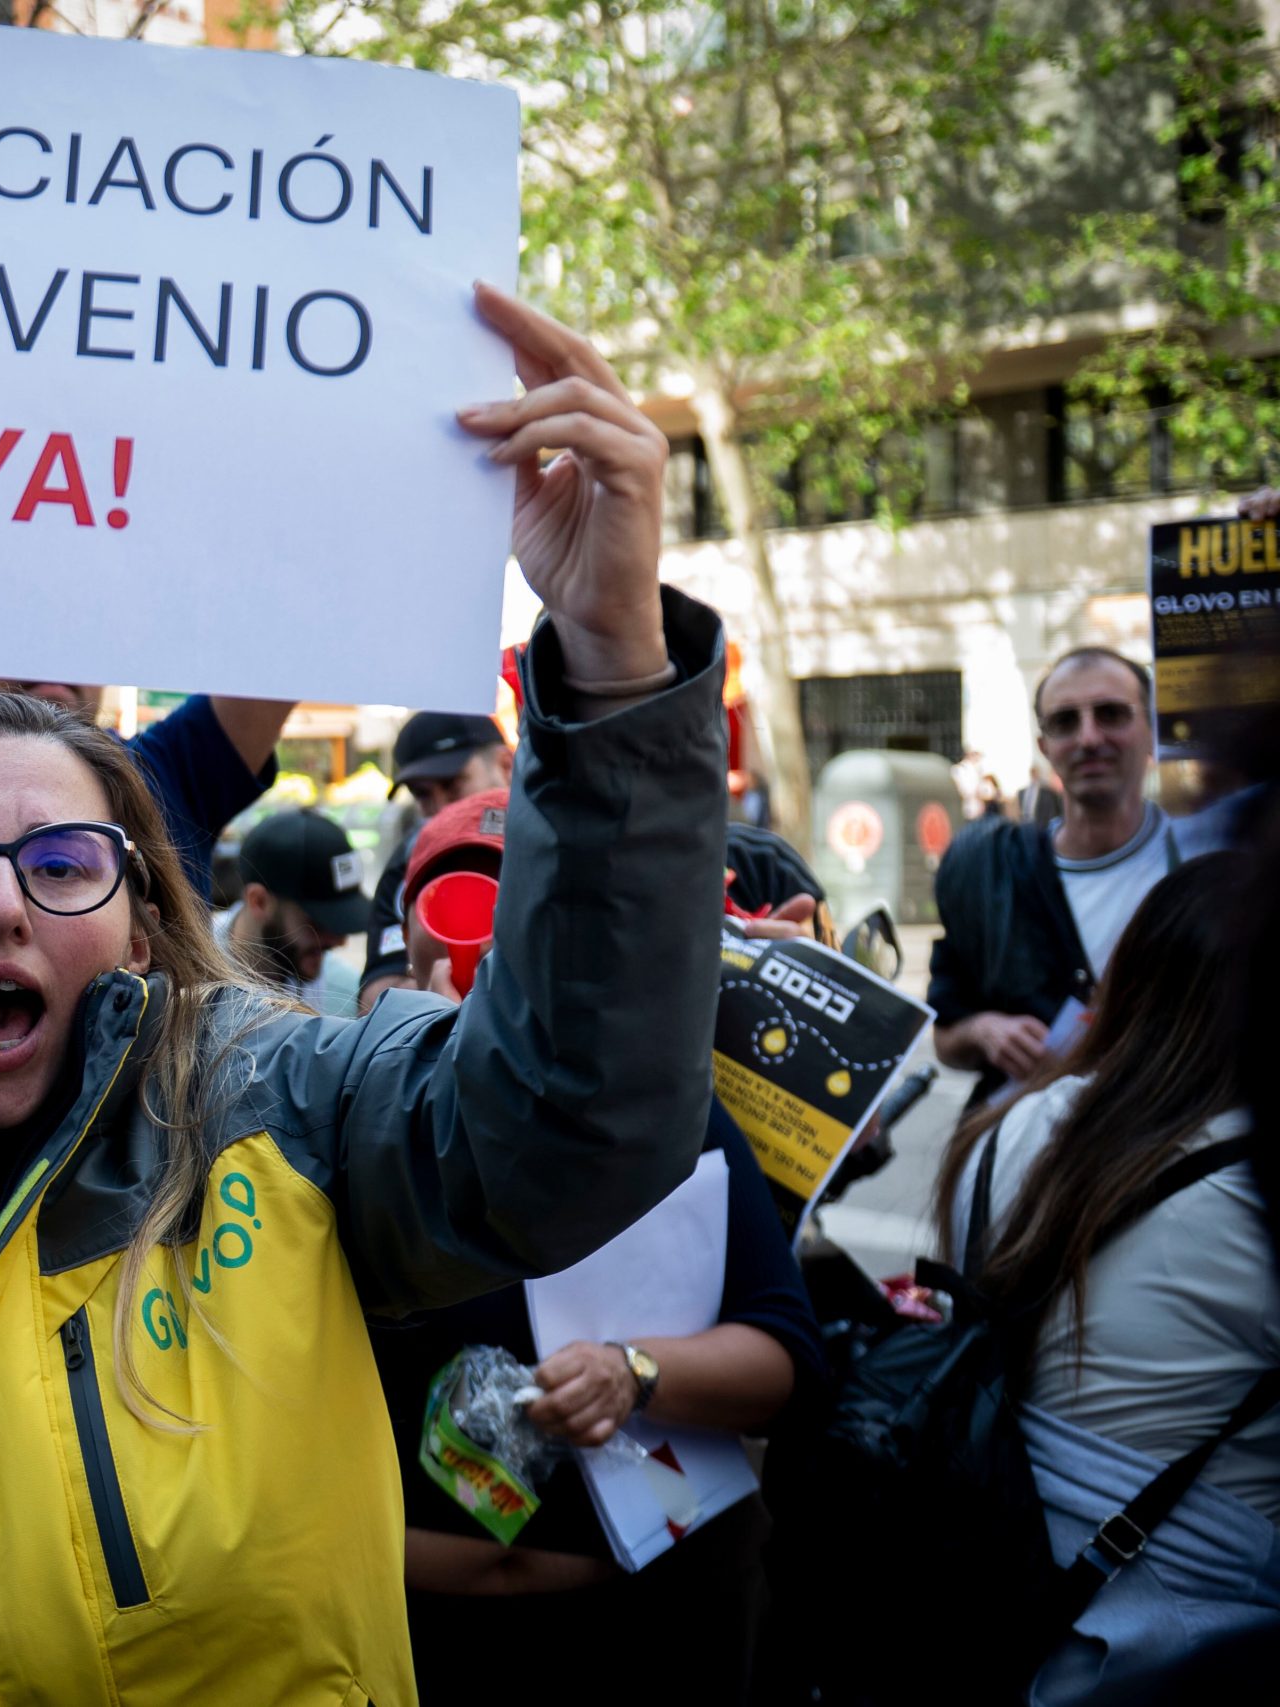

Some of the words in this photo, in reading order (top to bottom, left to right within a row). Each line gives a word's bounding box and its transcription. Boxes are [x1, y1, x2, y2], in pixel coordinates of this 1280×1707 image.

[1154, 592, 1235, 615] GLOVO
[1239, 589, 1271, 607] EN
[759, 957, 856, 1024] CCOO
